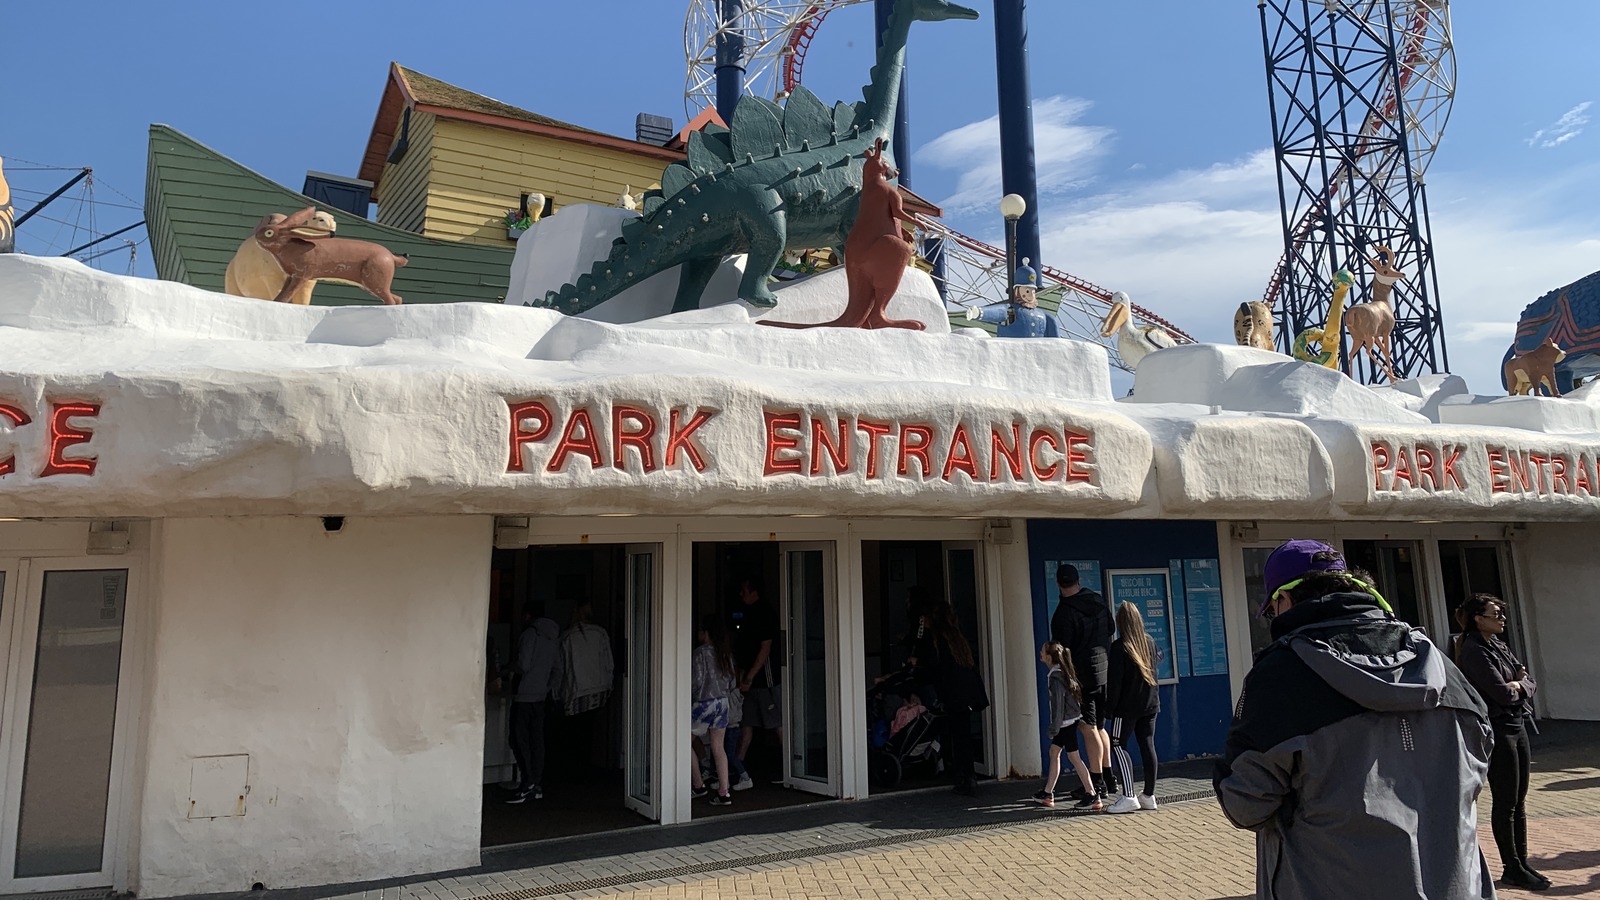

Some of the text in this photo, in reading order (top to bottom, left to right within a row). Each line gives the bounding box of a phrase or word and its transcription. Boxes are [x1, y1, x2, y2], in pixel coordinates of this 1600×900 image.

[507, 401, 1092, 483] PARK ENTRANCE
[1371, 443, 1600, 497] PARK ENTRA
